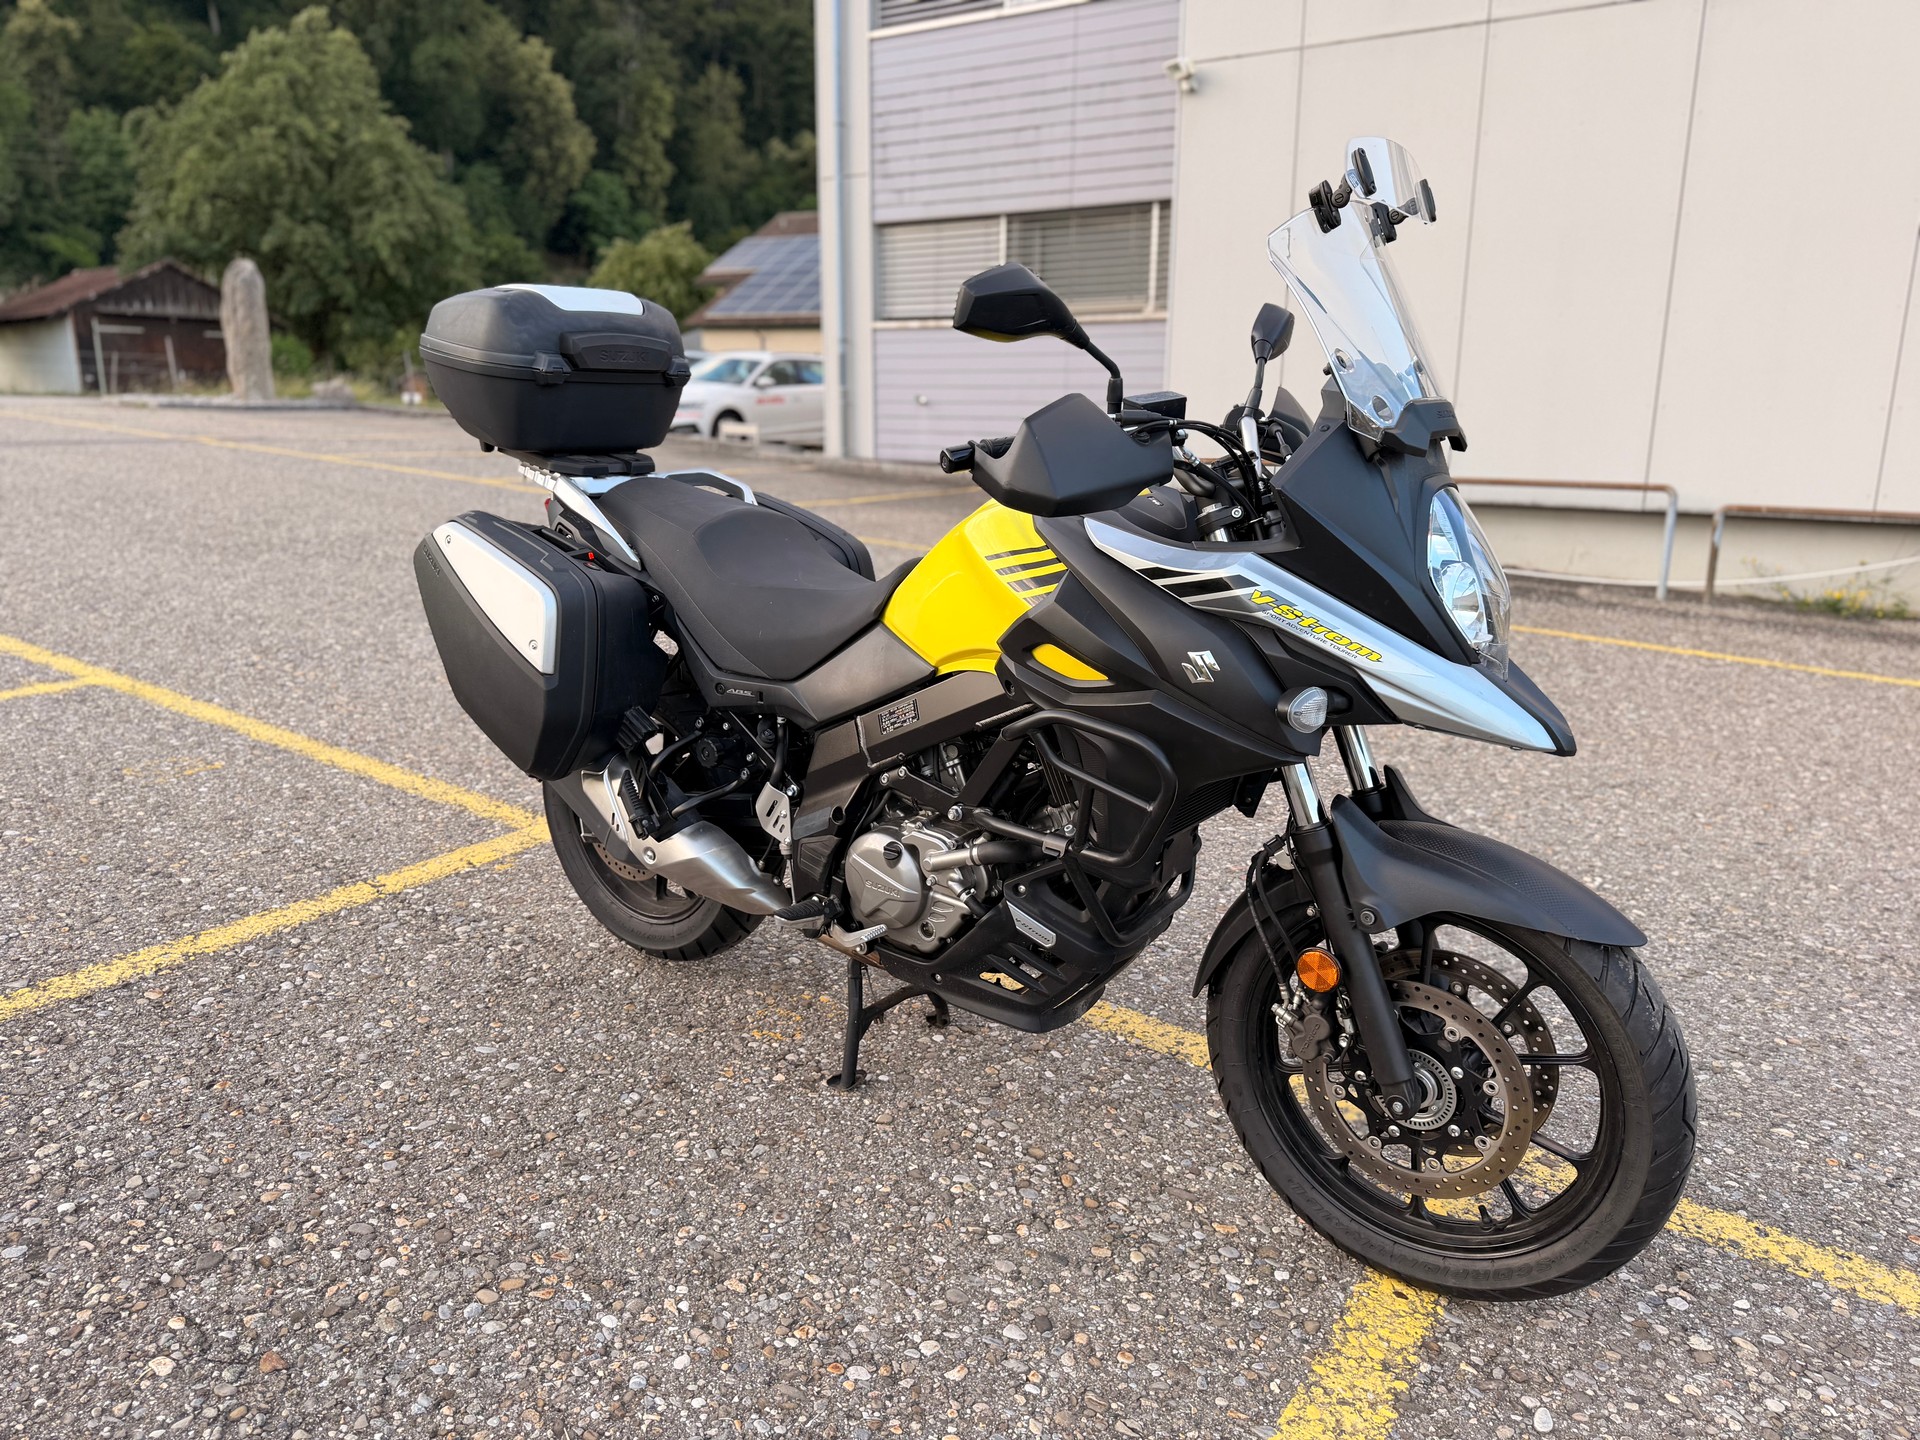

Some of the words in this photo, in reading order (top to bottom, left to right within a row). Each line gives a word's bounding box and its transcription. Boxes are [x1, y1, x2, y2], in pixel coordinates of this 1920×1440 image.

[1249, 589, 1383, 662] V-Strom
[1261, 609, 1286, 623] SPORT
[1286, 621, 1327, 645] ADVENTURE
[1329, 642, 1358, 660] TOURER
[865, 880, 900, 898] SUZUKI
